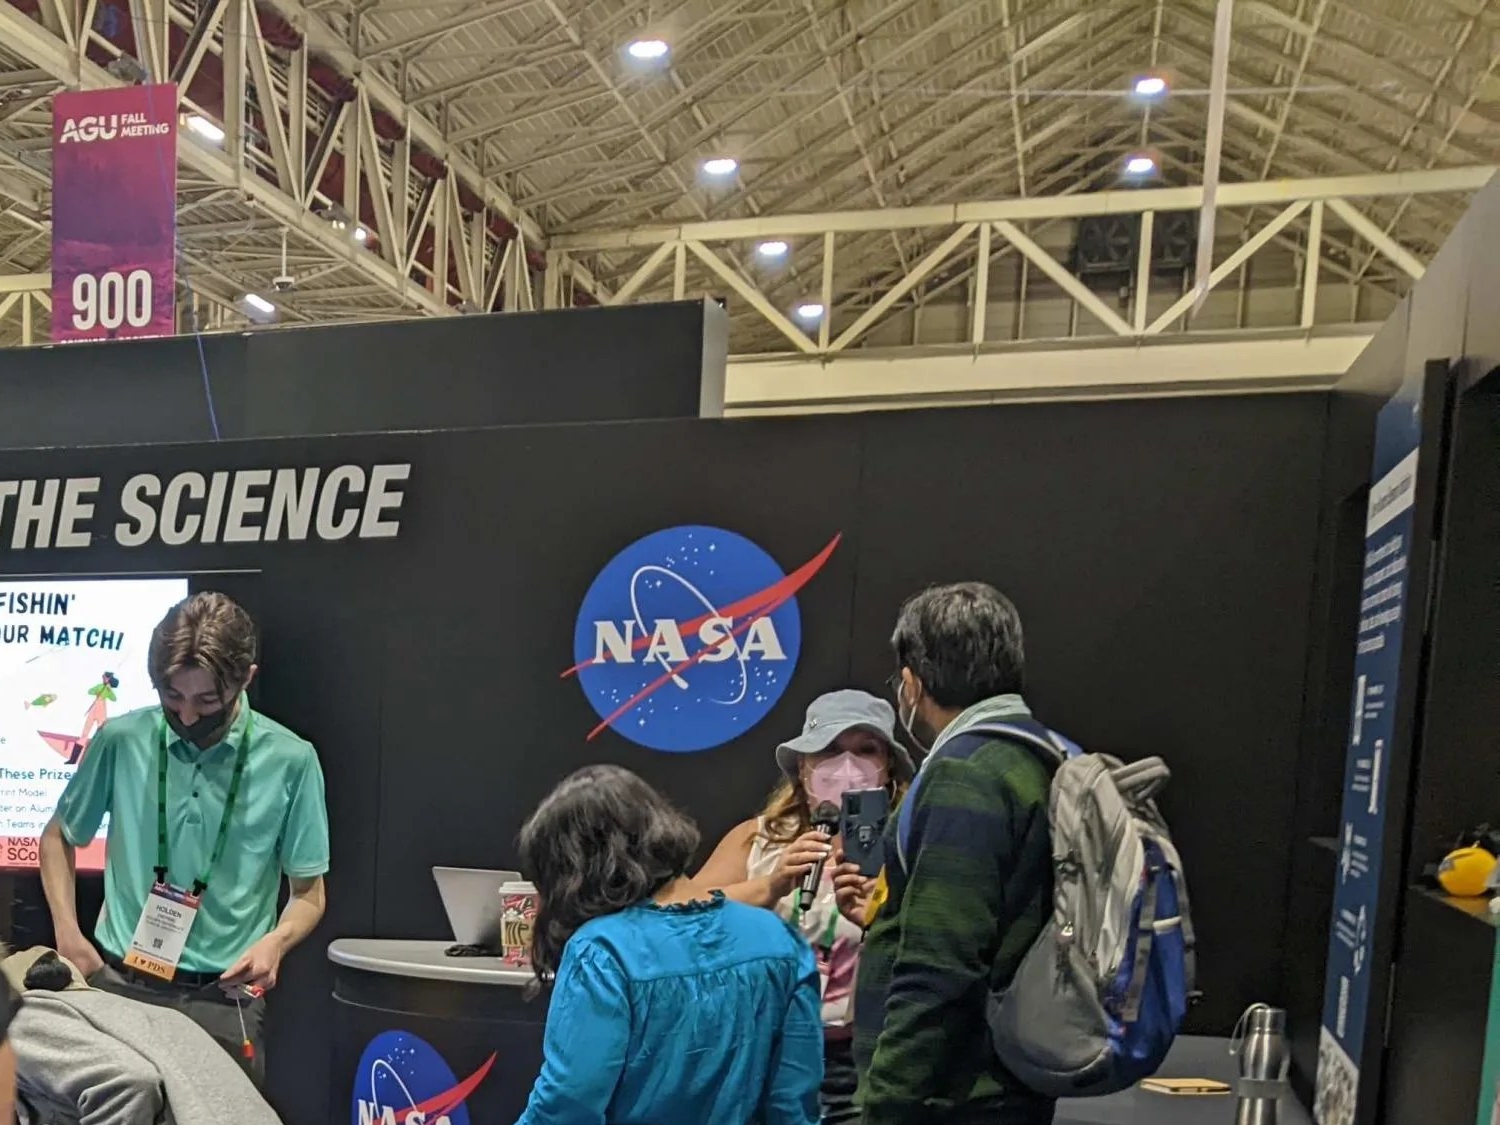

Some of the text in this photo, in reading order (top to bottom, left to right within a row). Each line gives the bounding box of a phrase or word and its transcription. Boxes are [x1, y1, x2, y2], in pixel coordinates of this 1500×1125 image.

[121, 112, 147, 124] FALL
[60, 115, 118, 143] AGU
[120, 123, 170, 137] MEETING
[72, 269, 153, 331] 900
[114, 463, 411, 548] SCIENCE
[592, 615, 788, 664] NASA
[39, 767, 74, 781] Prize
[18, 788, 47, 798] Model
[15, 805, 26, 813] on
[30, 803, 55, 813] Alum
[7, 818, 35, 829] Teams
[7, 837, 38, 847] NASA
[7, 847, 38, 861] SCo
